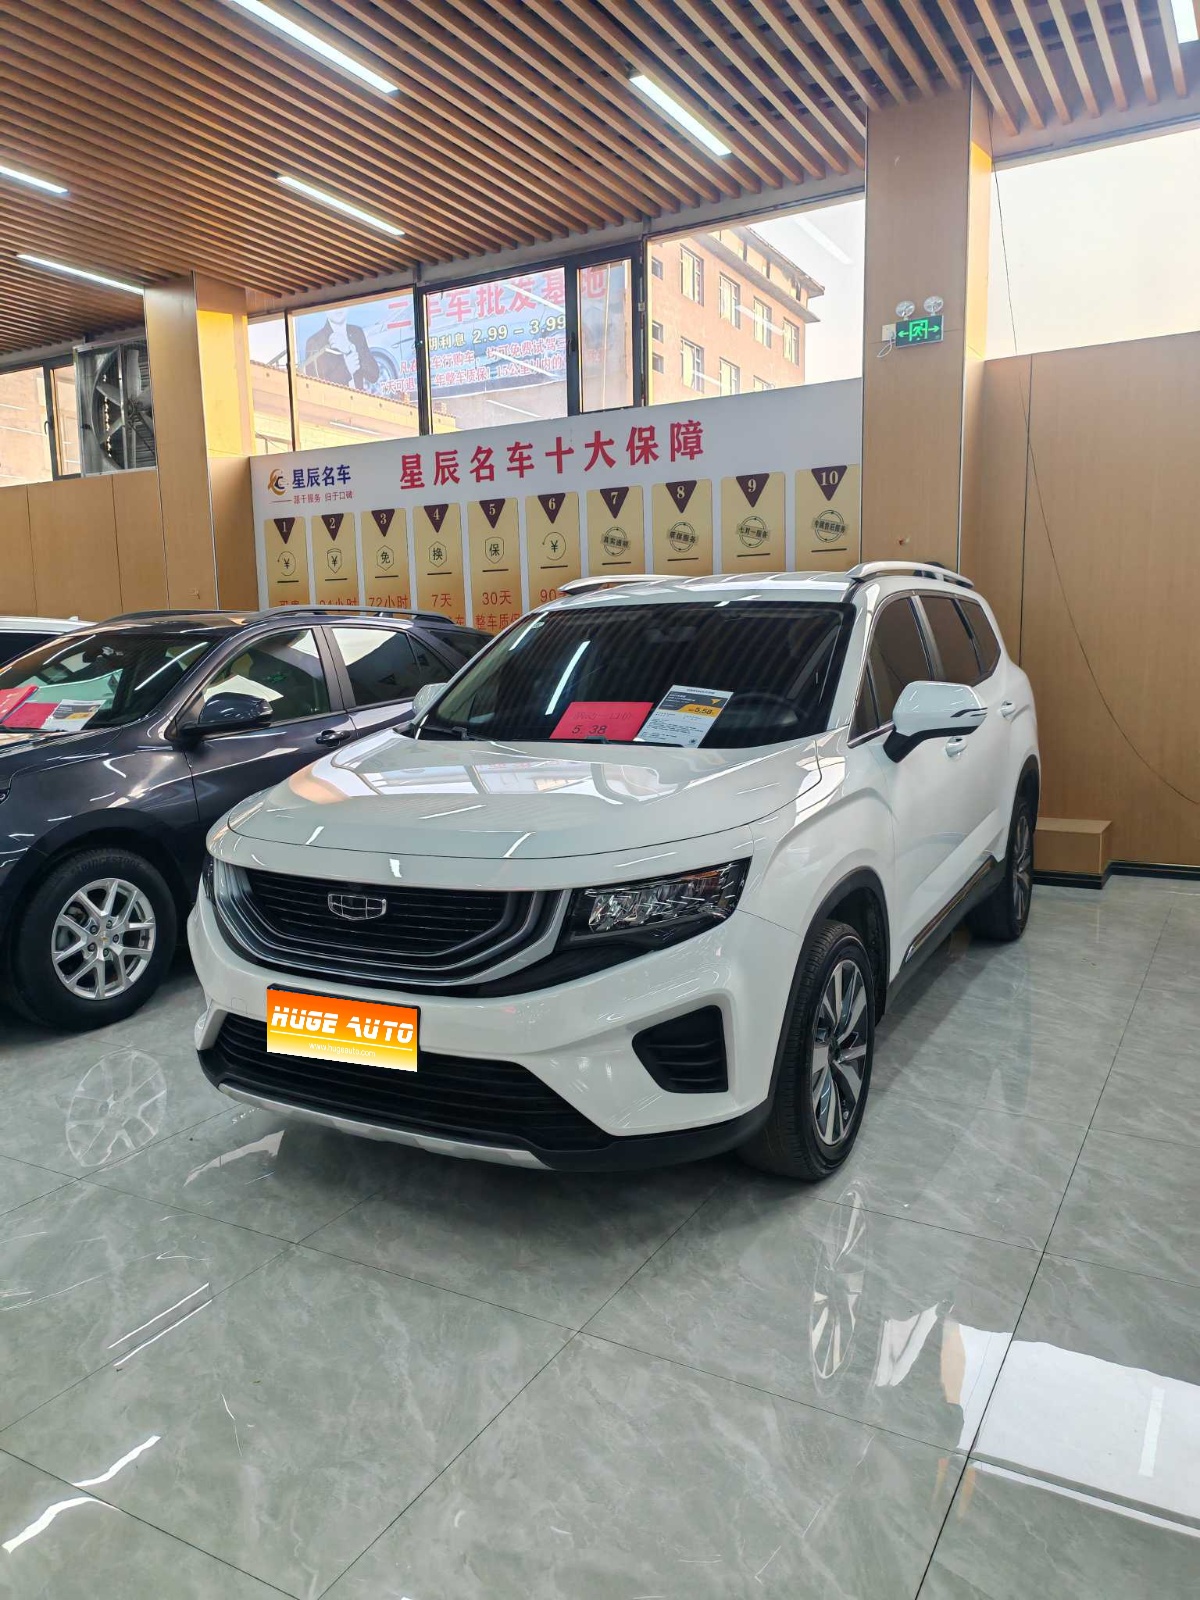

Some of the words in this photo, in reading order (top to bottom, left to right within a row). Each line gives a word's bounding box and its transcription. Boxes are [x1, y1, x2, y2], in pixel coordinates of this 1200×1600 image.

[472, 325, 508, 344] 2.99
[529, 314, 566, 335] 3.99
[400, 419, 704, 491] 星辰名车十大保障
[292, 464, 352, 490] 星辰名车
[820, 470, 840, 486] 10
[676, 485, 686, 499] 8
[747, 478, 757, 492] 9
[548, 498, 556, 510] 6
[610, 491, 619, 505] 7
[433, 509, 440, 521] 4
[489, 504, 496, 516] 5
[329, 518, 337, 529] 2
[380, 513, 388, 524] 3
[281, 521, 288, 533] 1
[489, 543, 501, 556] 保
[380, 552, 391, 564] 免
[431, 593, 452, 608] 7天
[482, 590, 512, 605] 30天
